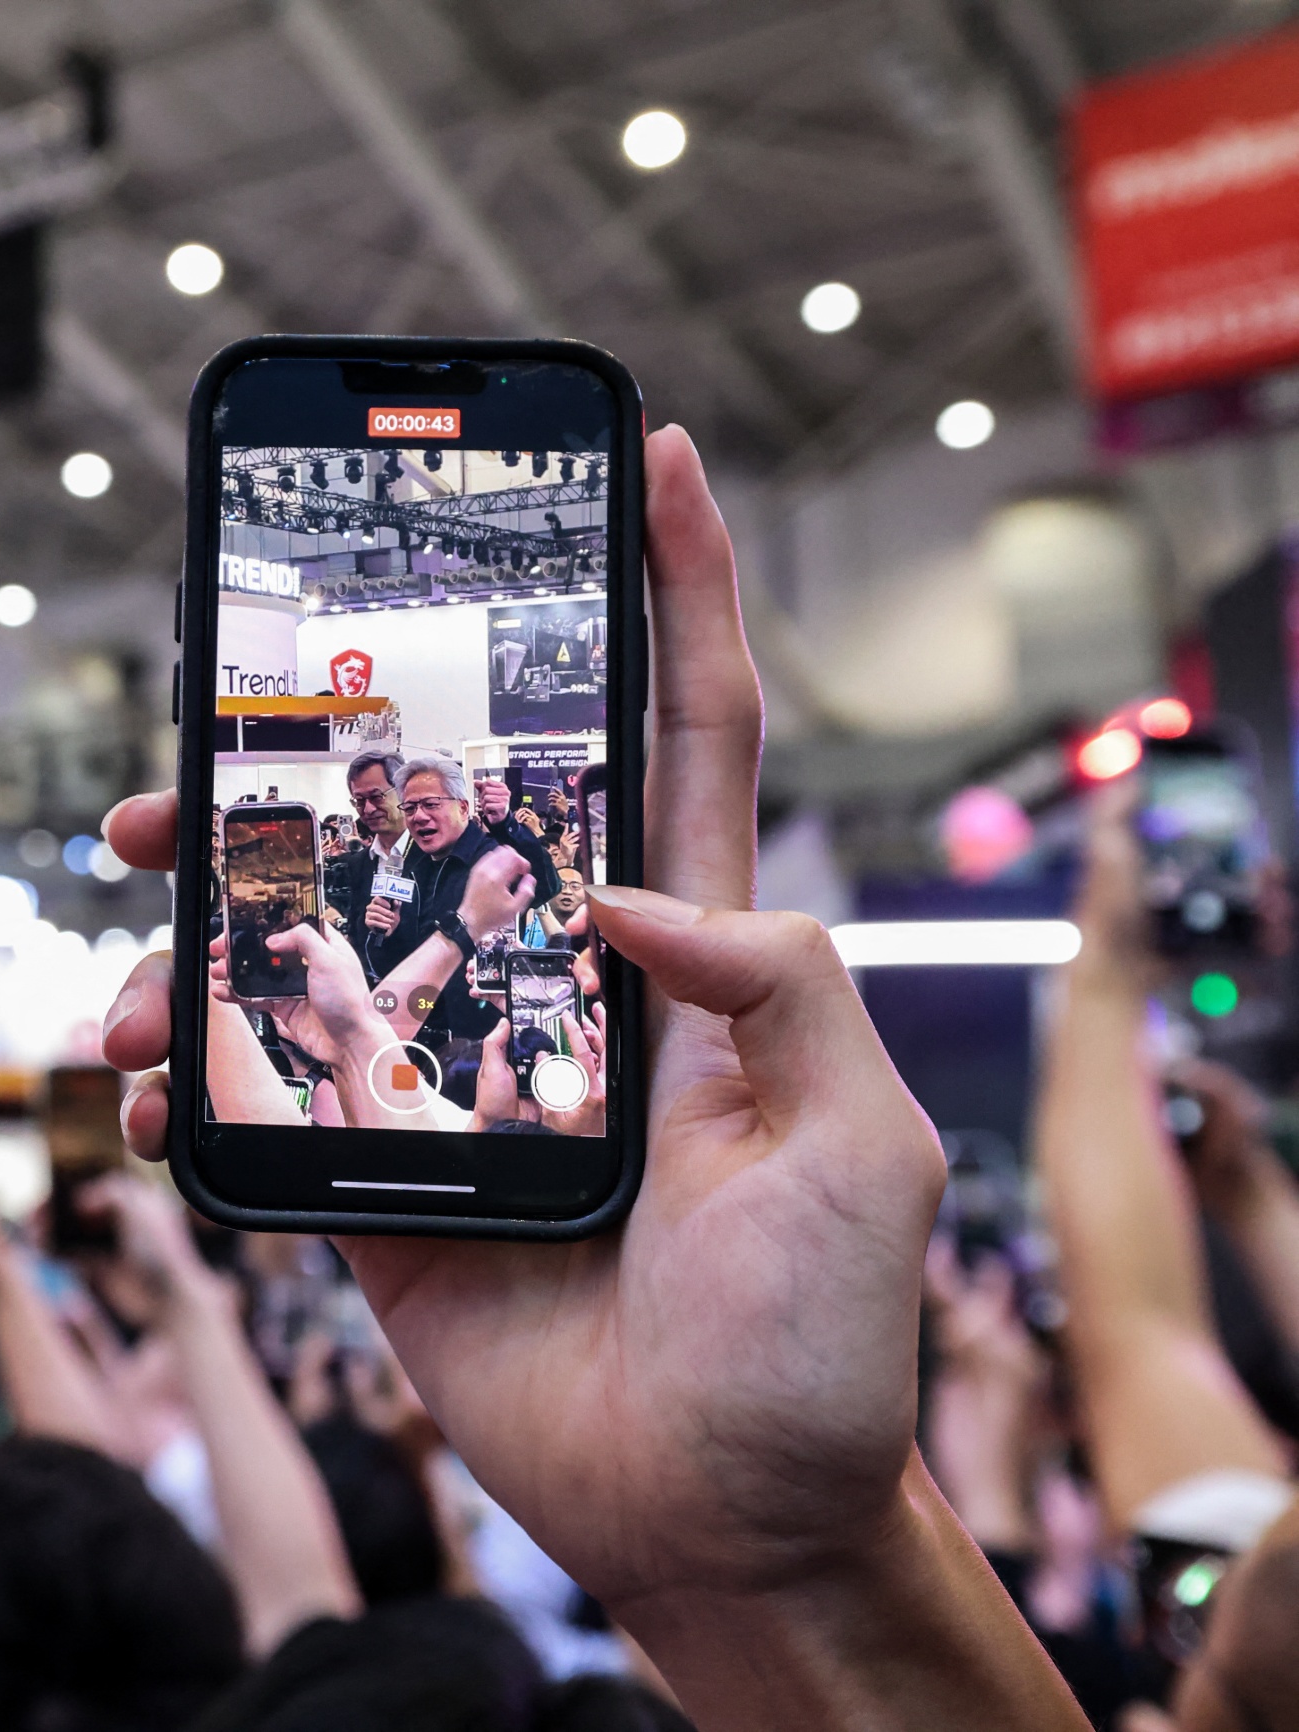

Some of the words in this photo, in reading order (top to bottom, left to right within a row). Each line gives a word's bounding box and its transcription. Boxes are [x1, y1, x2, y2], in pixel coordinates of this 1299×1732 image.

[374, 414, 456, 433] 00:00:43
[508, 750, 541, 760] STRONG
[376, 997, 395, 1008] 0.5
[417, 998, 435, 1010] 3x
